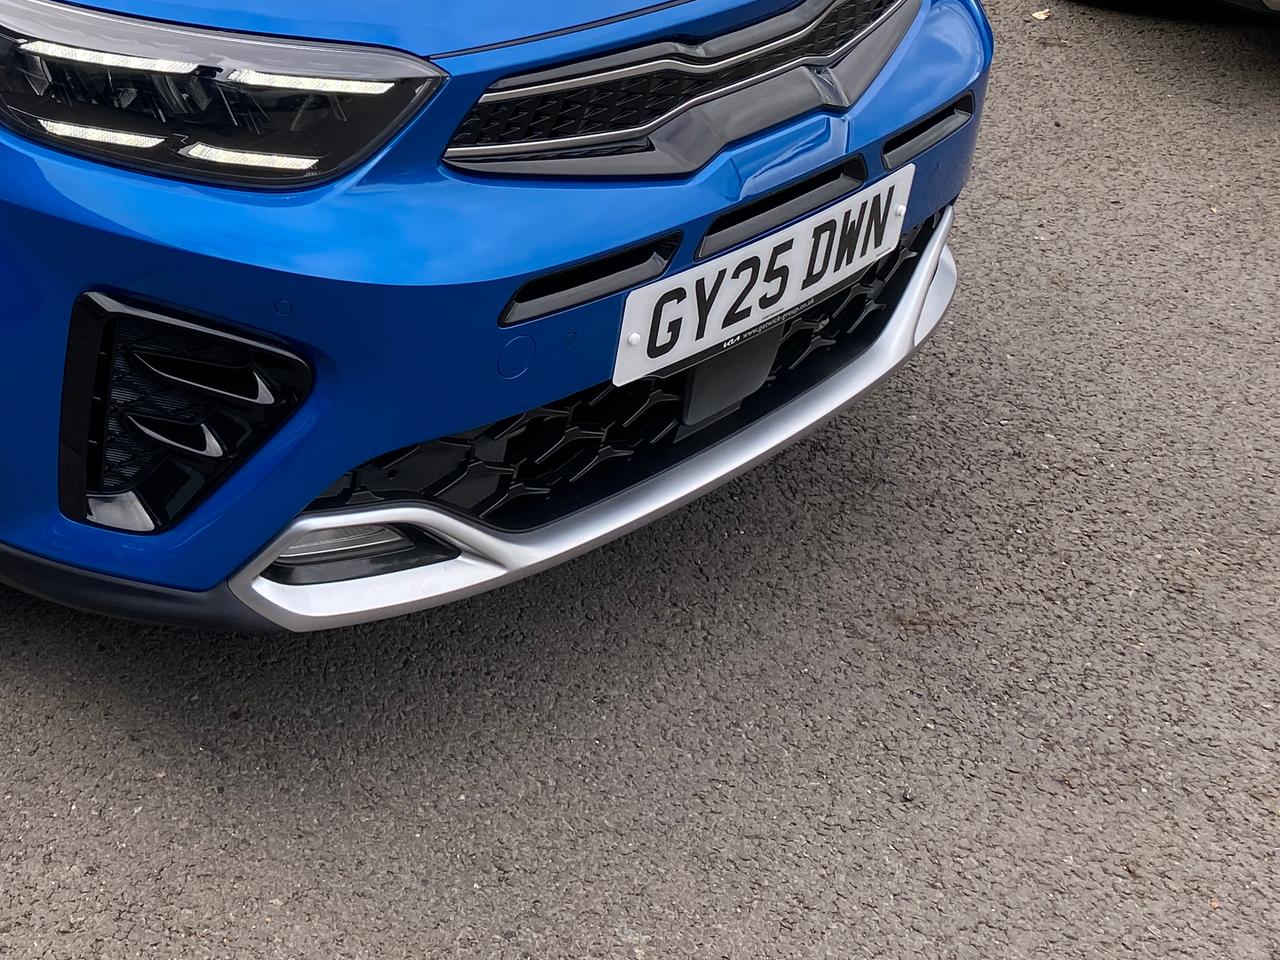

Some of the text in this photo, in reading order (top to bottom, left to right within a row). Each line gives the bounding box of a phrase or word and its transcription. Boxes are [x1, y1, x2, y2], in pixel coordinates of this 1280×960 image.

[646, 184, 895, 359] GY25 DWN
[723, 335, 740, 349] KIA
